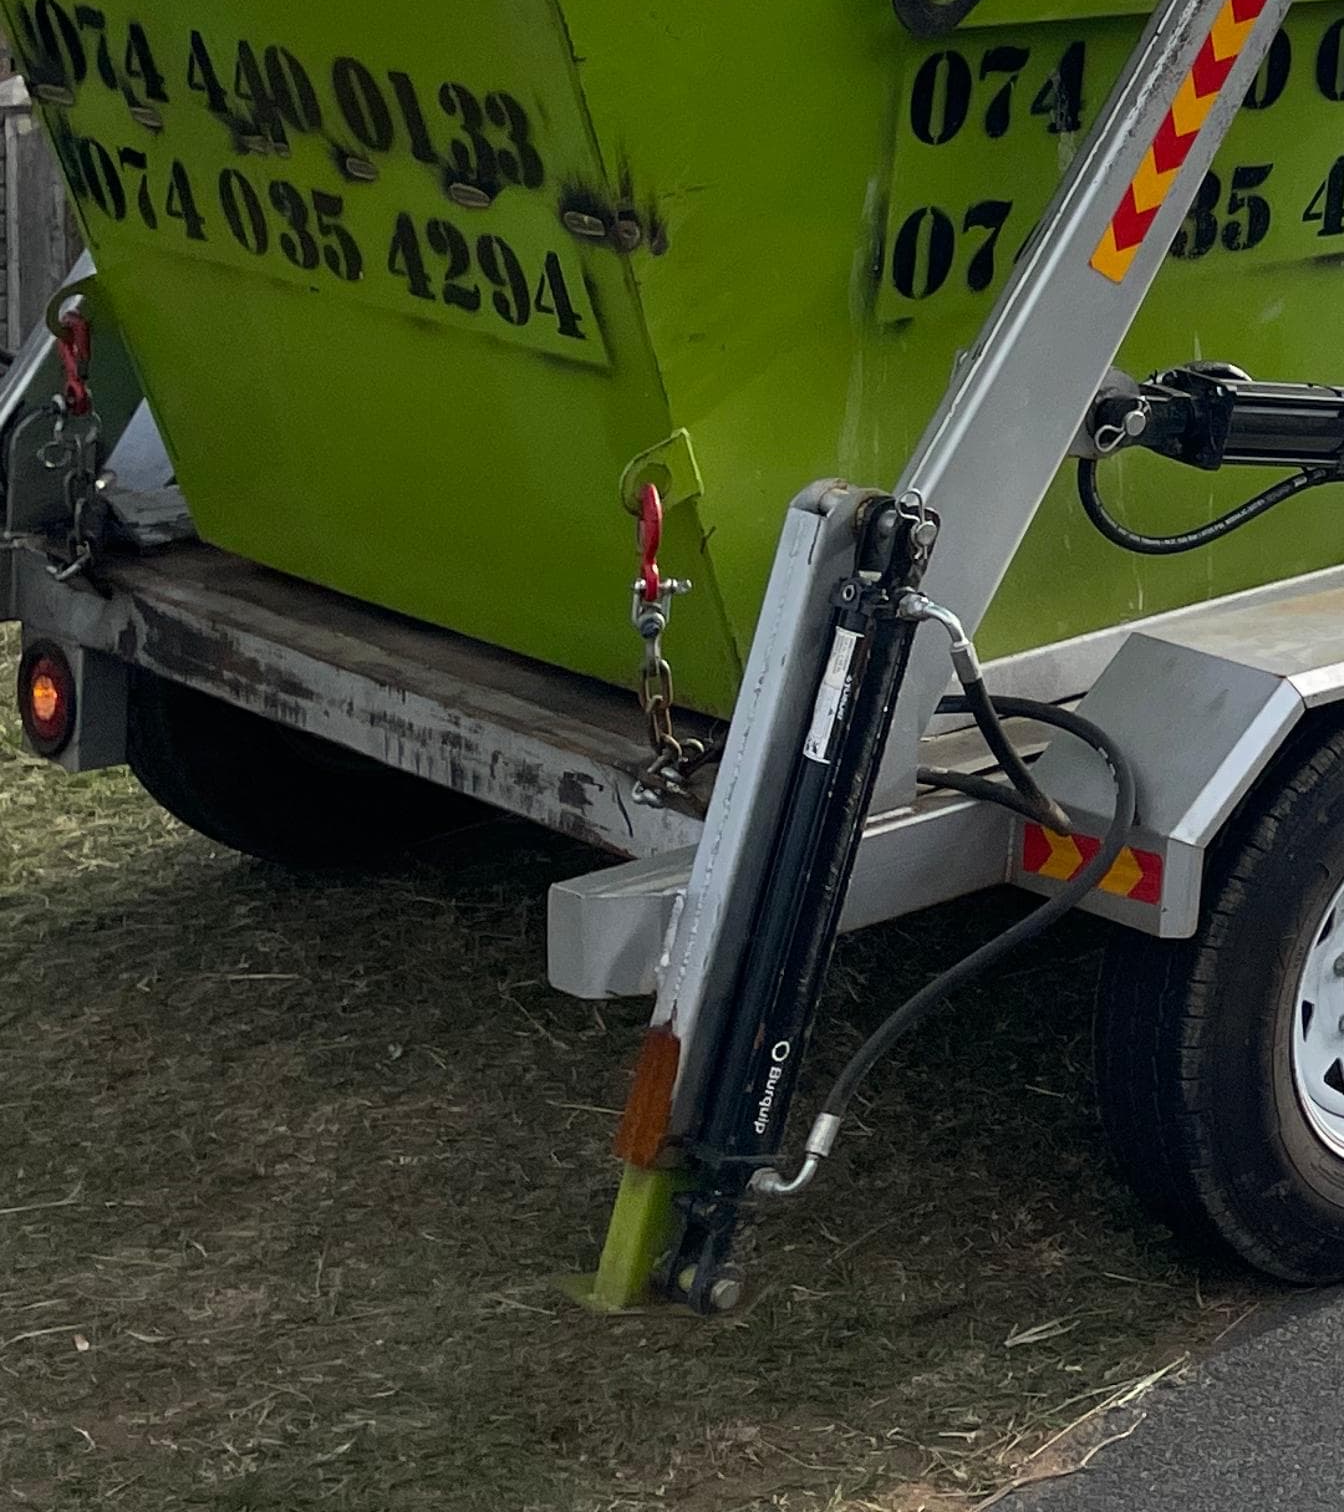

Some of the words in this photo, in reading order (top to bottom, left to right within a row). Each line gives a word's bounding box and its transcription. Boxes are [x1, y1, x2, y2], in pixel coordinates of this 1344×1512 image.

[187, 29, 323, 146] 440
[331, 54, 545, 190] 0133
[911, 40, 1087, 147] 074
[78, 137, 208, 241] 074
[218, 167, 364, 281] 035
[387, 211, 587, 340] 4294
[892, 200, 1046, 301] 07
[1168, 162, 1274, 261] 35
[753, 1065, 783, 1135] Burquip
